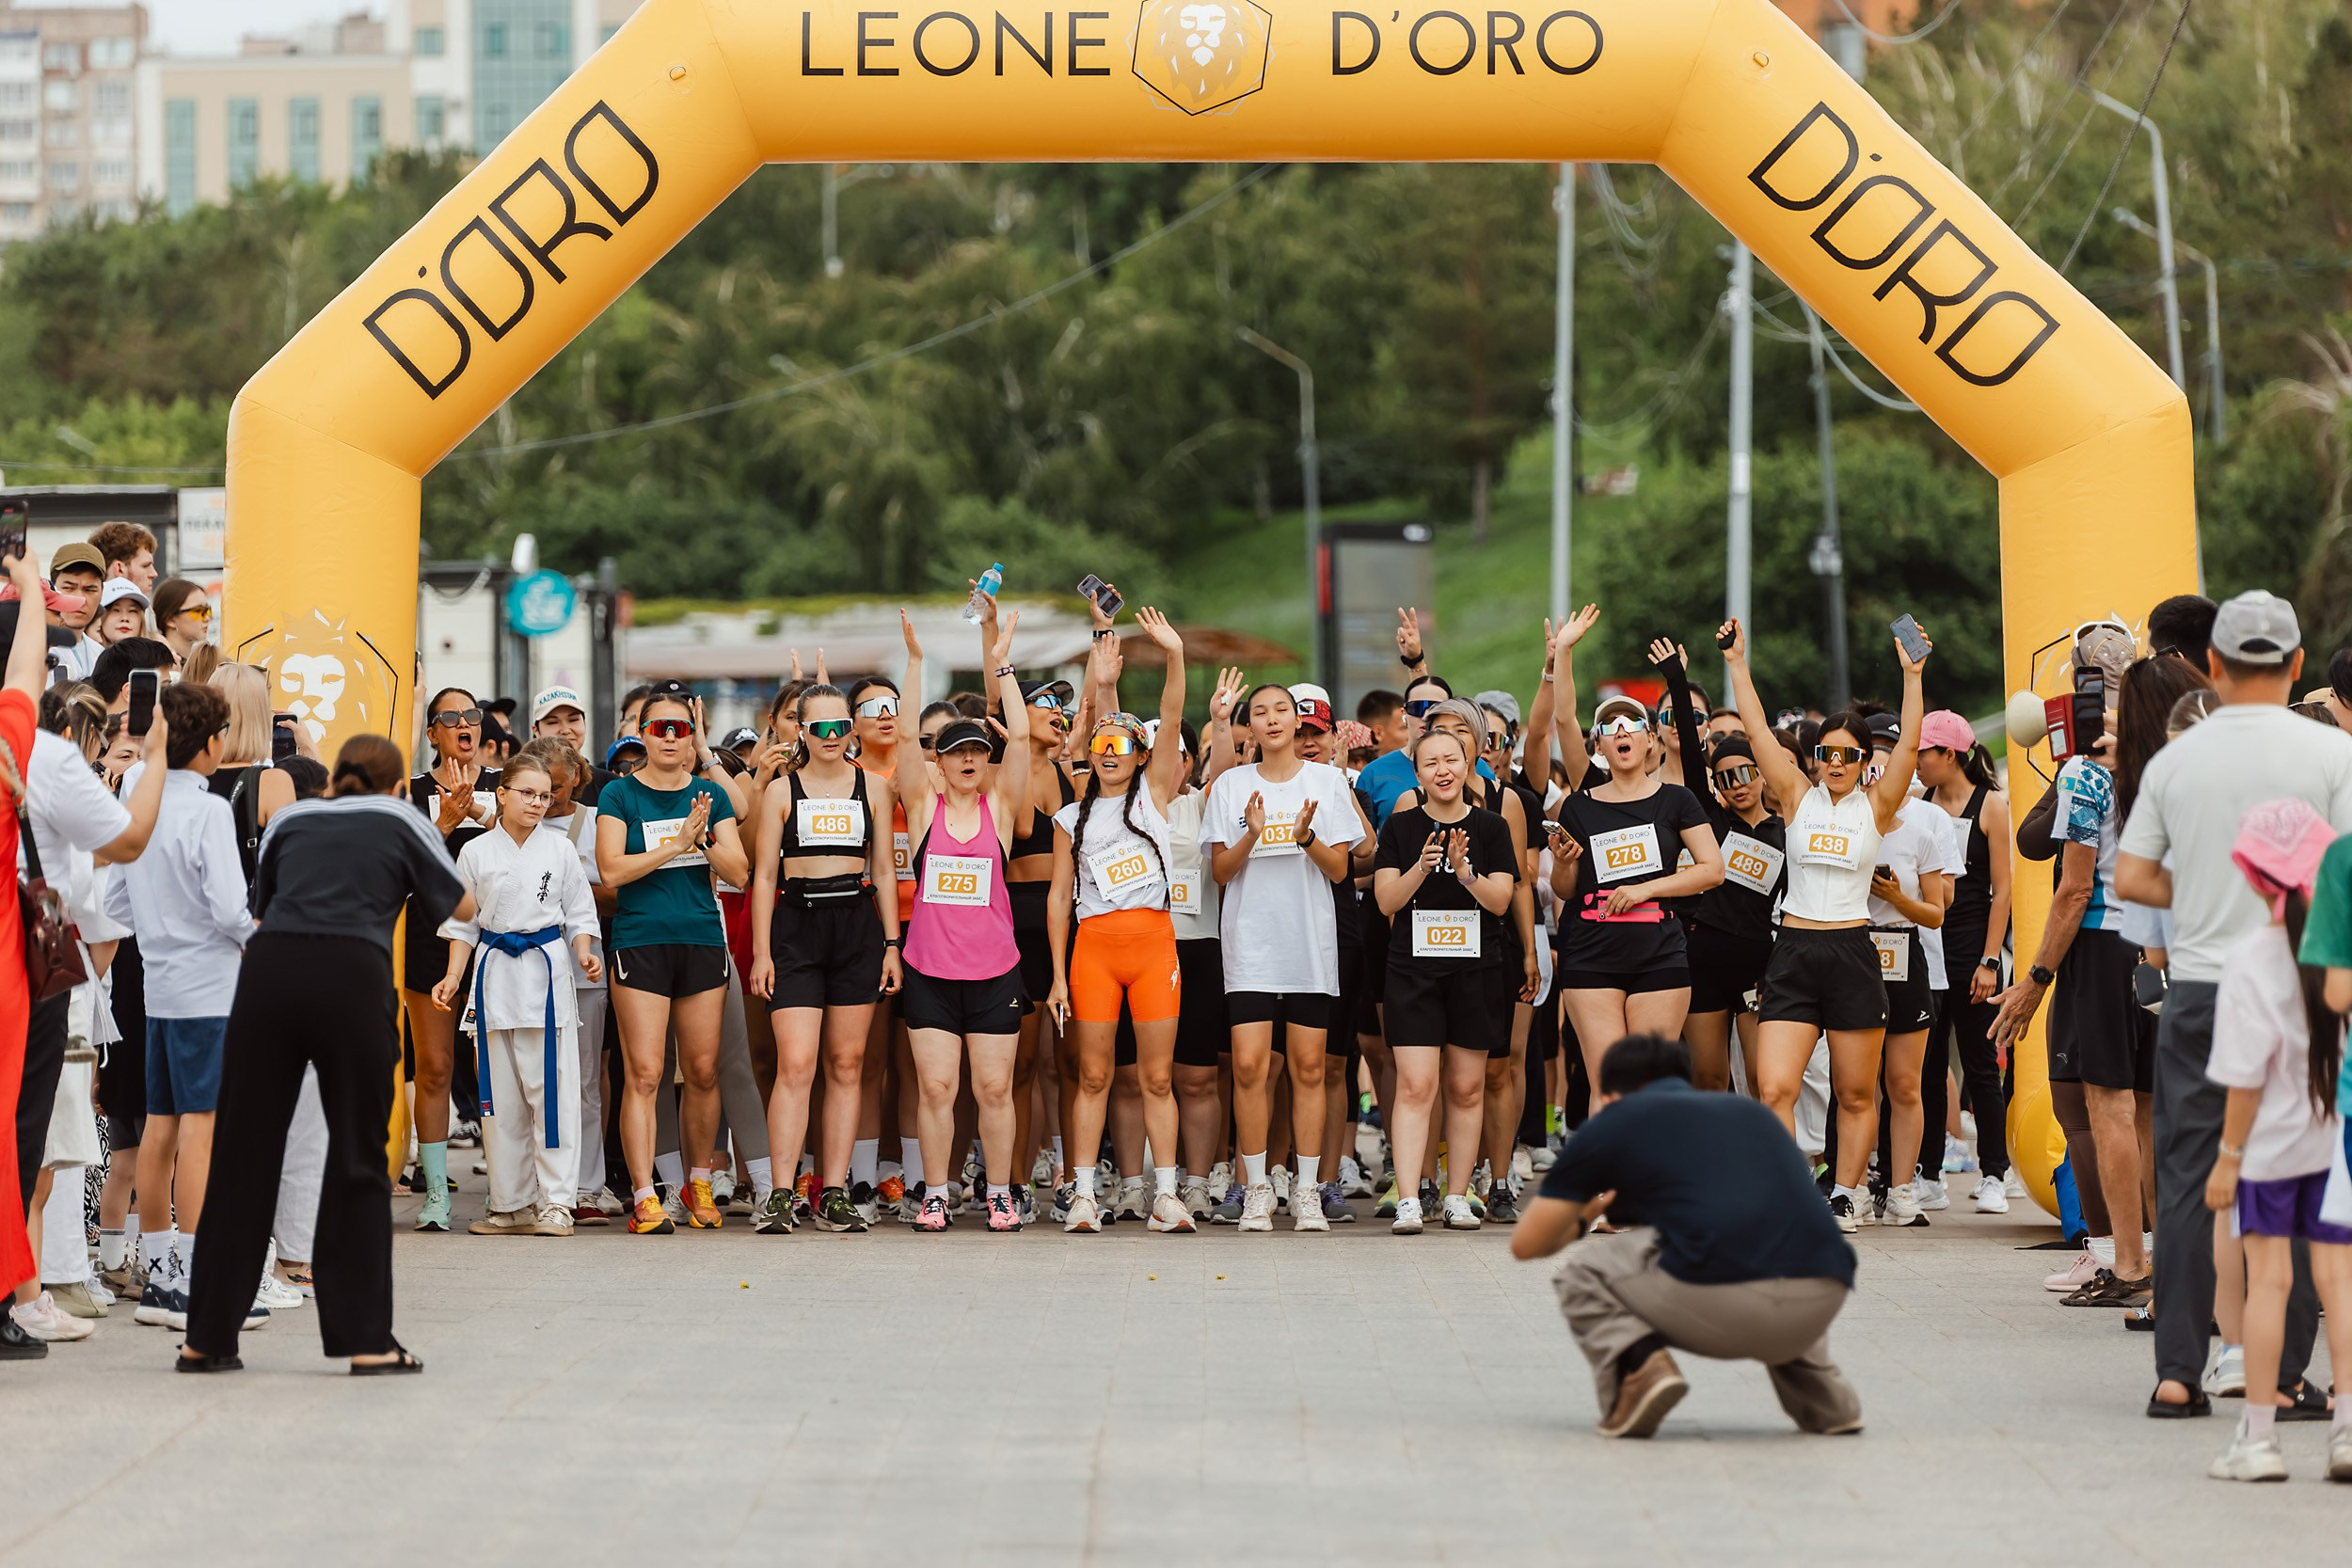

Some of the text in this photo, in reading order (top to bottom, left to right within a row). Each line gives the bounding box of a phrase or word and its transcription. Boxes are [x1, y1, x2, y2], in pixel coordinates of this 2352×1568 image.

[802, 10, 1604, 77] LEONE D'ORO
[362, 100, 660, 402] D'ORO
[1747, 101, 2060, 387] D'ORO
[539, 691, 578, 705] KAZAKHSTAN
[649, 826, 672, 834] LEONE
[816, 817, 847, 832] 486
[1264, 826, 1294, 842] 037
[1596, 837, 1618, 847] LEONE
[1729, 838, 1750, 849] LEONE
[1812, 835, 1844, 853] 438
[1095, 853, 1118, 866] LEONE
[1610, 846, 1642, 866] 278
[1111, 858, 1143, 882] 260
[1732, 854, 1763, 876] 489
[941, 875, 974, 892] 275
[1431, 928, 1462, 943] 022
